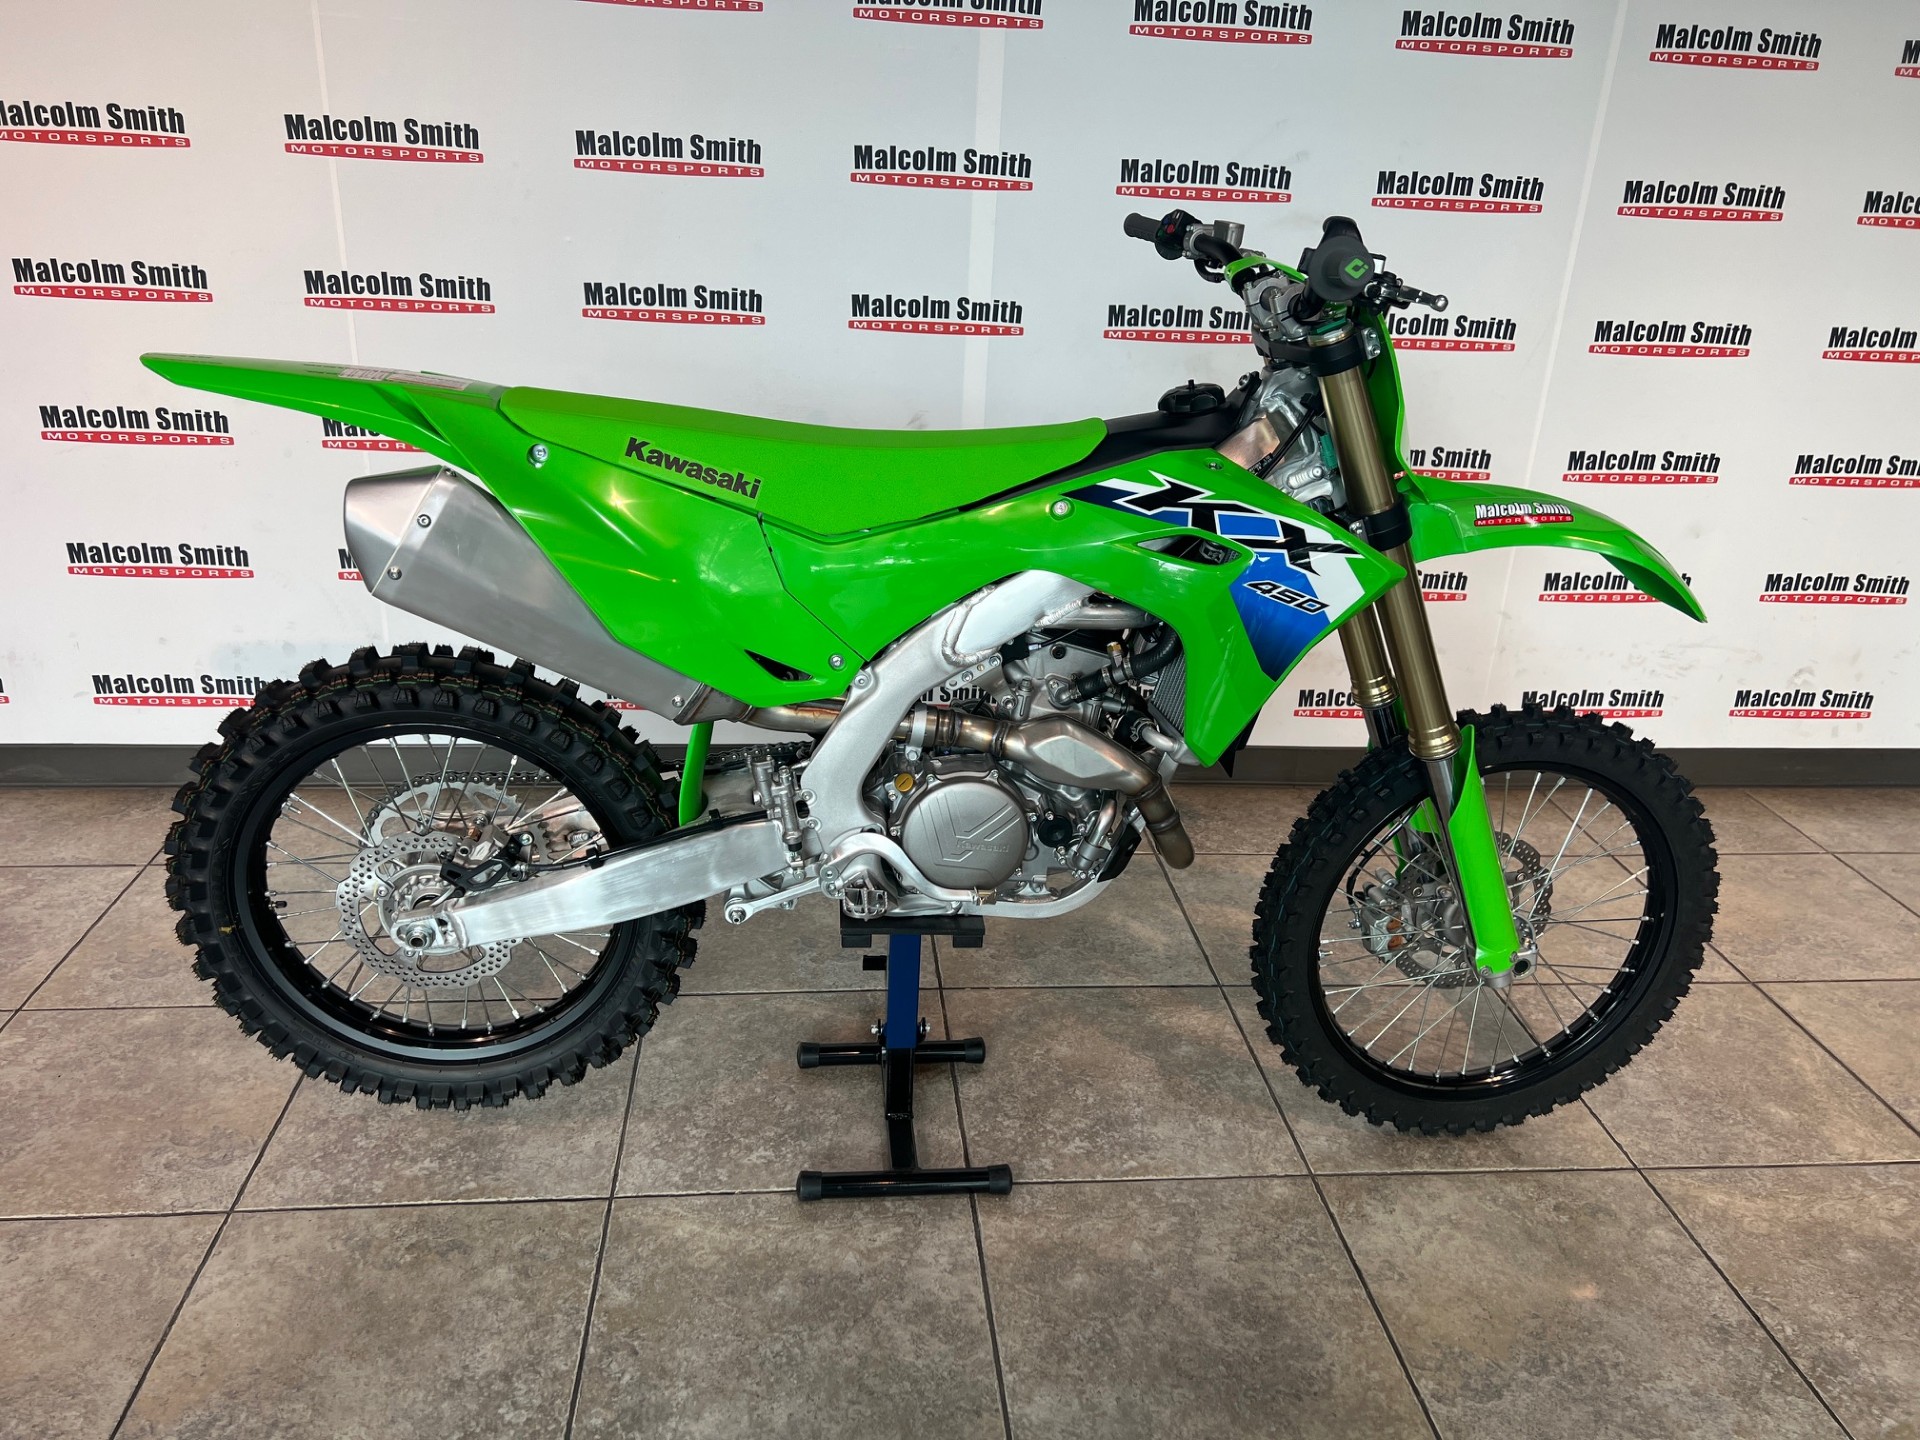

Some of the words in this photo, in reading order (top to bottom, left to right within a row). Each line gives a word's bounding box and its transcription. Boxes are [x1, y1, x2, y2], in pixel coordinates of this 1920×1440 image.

[613, 0, 759, 10] SPORTS
[859, 9, 1039, 28] MOTORSPORTS
[1134, 0, 1237, 24] Malcolm
[1244, 0, 1312, 31] Smith
[1134, 26, 1309, 43] MOTORSPORTS
[1401, 11, 1502, 39] Malcolm
[1507, 14, 1574, 45] Smith
[1401, 41, 1569, 57] MOTORSPORTS
[1656, 24, 1753, 51] Malcolm
[1758, 28, 1822, 58] Smith
[1655, 53, 1815, 70] MOTORSPORTS
[106, 103, 185, 134] Smith
[284, 114, 397, 143] Malcolm
[404, 119, 479, 149] Smith
[291, 145, 480, 162] MOTORSPORTS
[576, 130, 683, 158] Malcolm
[690, 135, 761, 164] Smith
[579, 160, 760, 176] MOTORSPORTS
[854, 145, 956, 172] Malcolm
[964, 149, 1031, 178] Smith
[856, 174, 1029, 190] MOTORSPORTS
[1121, 159, 1219, 184] Malcolm
[1226, 162, 1291, 190] Smith
[1121, 187, 1287, 201] MOTORSPORTS
[1377, 171, 1473, 196] Malcolm
[1479, 174, 1544, 201] Smith
[1624, 181, 1718, 204] Malcolm
[1723, 183, 1785, 209] Smith
[1376, 199, 1539, 212] MOTORSPORTS
[1863, 191, 1920, 214] Malc
[1622, 208, 1779, 220] MOTORSPORTS
[12, 259, 125, 284] Malcolm
[131, 261, 207, 289] Smith
[19, 287, 209, 301] MOTORSPORTS
[304, 271, 412, 296] Malcolm
[420, 273, 490, 301] Smith
[310, 298, 491, 313] MOTORSPORTS
[584, 283, 686, 307] Malcolm
[694, 285, 762, 312] Smith
[587, 310, 762, 324] MOTORSPORTS
[852, 294, 949, 319] Malcolm
[957, 297, 1022, 324] Smith
[1108, 305, 1203, 328] Malcolm
[1209, 306, 1251, 330] Smi
[854, 321, 1019, 335] MOTORSPORTS
[1108, 331, 1252, 342] MOTORSPORT
[1388, 314, 1449, 336] lcolm
[1454, 315, 1516, 340] Smith
[1594, 321, 1686, 342] Malcolm
[1691, 322, 1751, 345] Smith
[1393, 340, 1512, 351] ORSPORTS
[1828, 327, 1917, 348] Malcolm
[1593, 346, 1746, 356] MOTORSPORTS
[1827, 351, 1920, 361] MOTORSP
[39, 406, 149, 429] Malcolm
[156, 408, 229, 433] Smith
[47, 432, 230, 445] MOTORSPORTS
[1431, 447, 1491, 469] Smith
[1568, 451, 1656, 470] Malcolm
[1661, 451, 1720, 473] Smith
[1795, 455, 1882, 474] Malcolm
[624, 437, 762, 499] Kawasaki
[1567, 474, 1715, 484] MOTORSPORTS
[1793, 477, 1920, 487] MOTORSPOR
[1475, 503, 1532, 518] Malcolm
[1535, 502, 1571, 515] Smith
[1477, 516, 1572, 526] MOTORPORTS
[66, 543, 172, 563] Malcolm
[179, 544, 248, 567] Smith
[73, 567, 251, 578] MOTORSPORTS
[1417, 570, 1468, 591] mith
[1544, 572, 1628, 591] Malcolm
[1765, 573, 1849, 592] Malcolm
[1854, 574, 1909, 594] Smith
[1243, 580, 1330, 615] 450
[1543, 594, 1655, 602] MOTORSPO
[1764, 594, 1904, 605] MOTORSPORTS
[92, 675, 194, 694] Malcolm
[99, 697, 254, 706] MOTORSPORT
[1298, 689, 1354, 707] Malc
[1609, 690, 1664, 708] Smith
[1735, 690, 1816, 707] Malcolm
[1820, 690, 1873, 709] Smith
[1733, 709, 1869, 718] MOTORSPORTS
